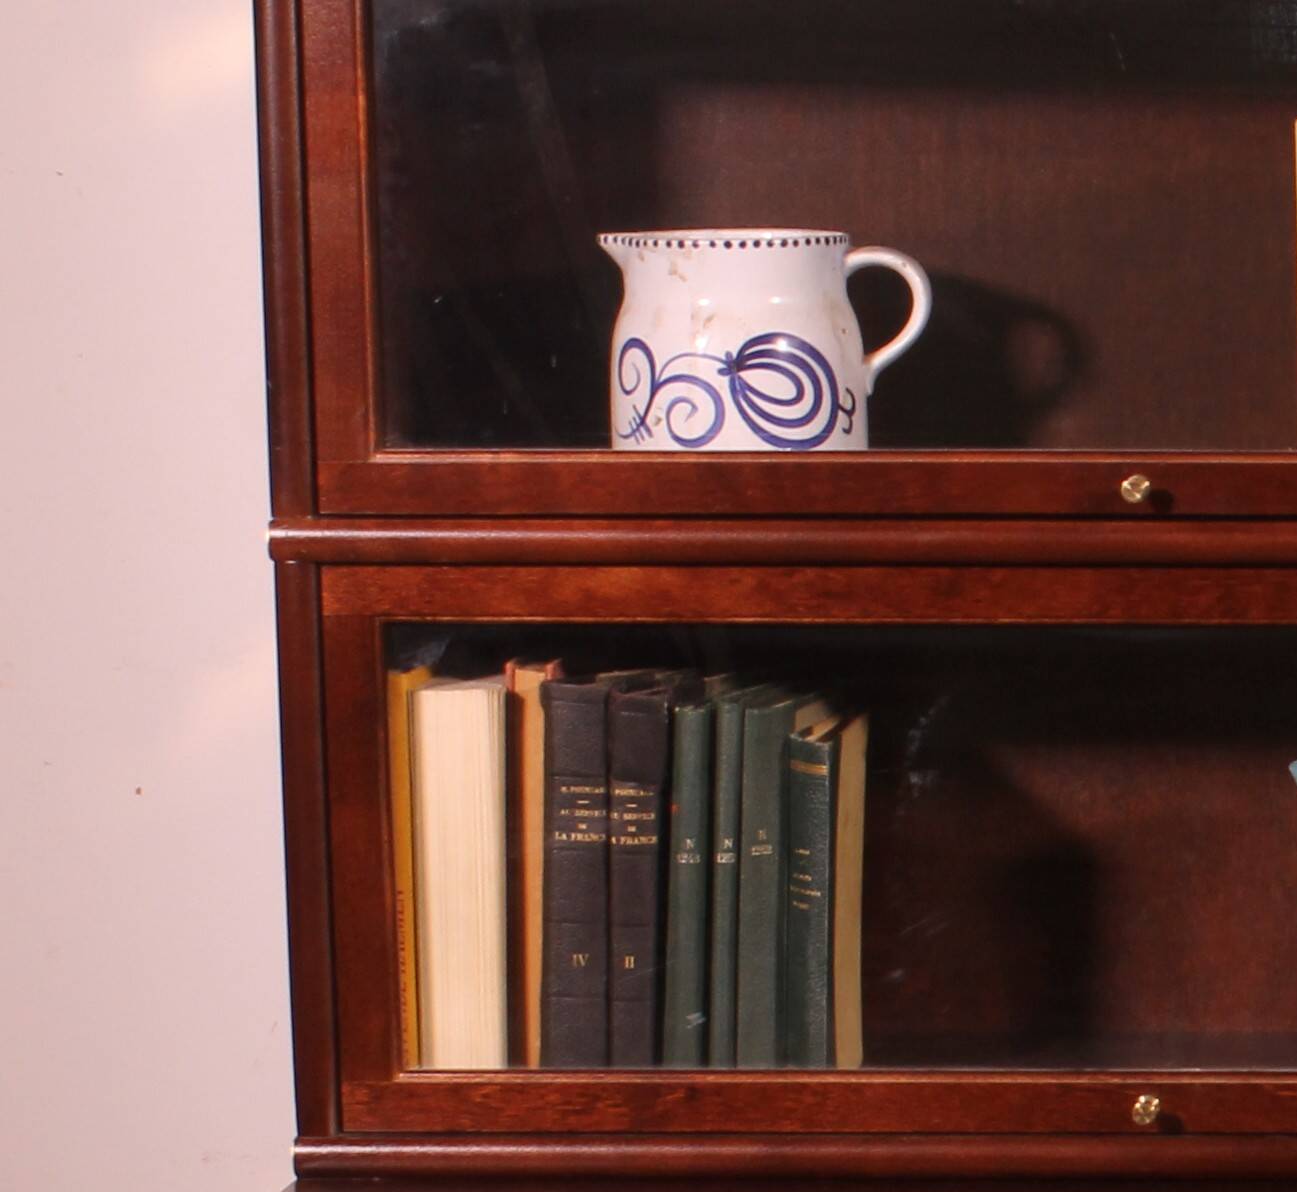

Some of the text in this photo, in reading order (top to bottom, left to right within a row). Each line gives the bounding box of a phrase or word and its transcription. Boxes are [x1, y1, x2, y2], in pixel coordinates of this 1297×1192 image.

[554, 831, 606, 842] LA FRANC
[723, 838, 734, 849] N
[572, 953, 590, 968] IV
[624, 955, 636, 970] II
